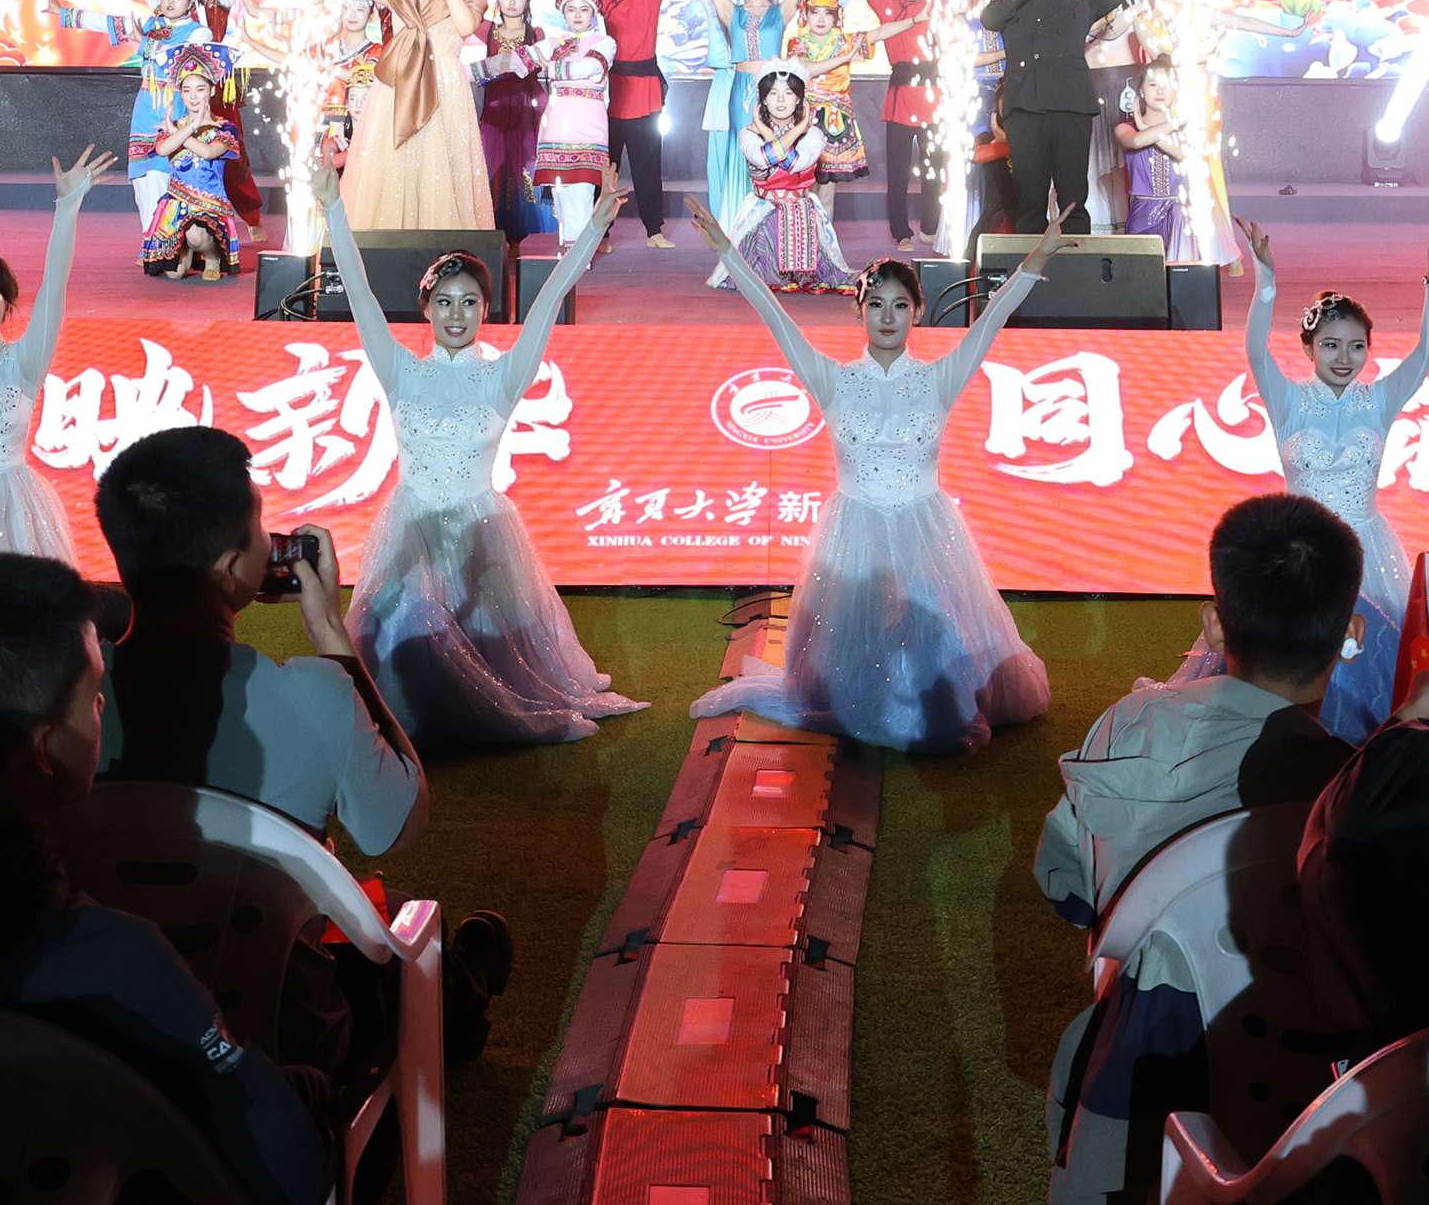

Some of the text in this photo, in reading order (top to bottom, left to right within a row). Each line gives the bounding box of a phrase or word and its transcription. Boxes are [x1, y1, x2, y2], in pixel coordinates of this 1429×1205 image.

[587, 535, 811, 547] XINHUA COLLEGE OF NIN
